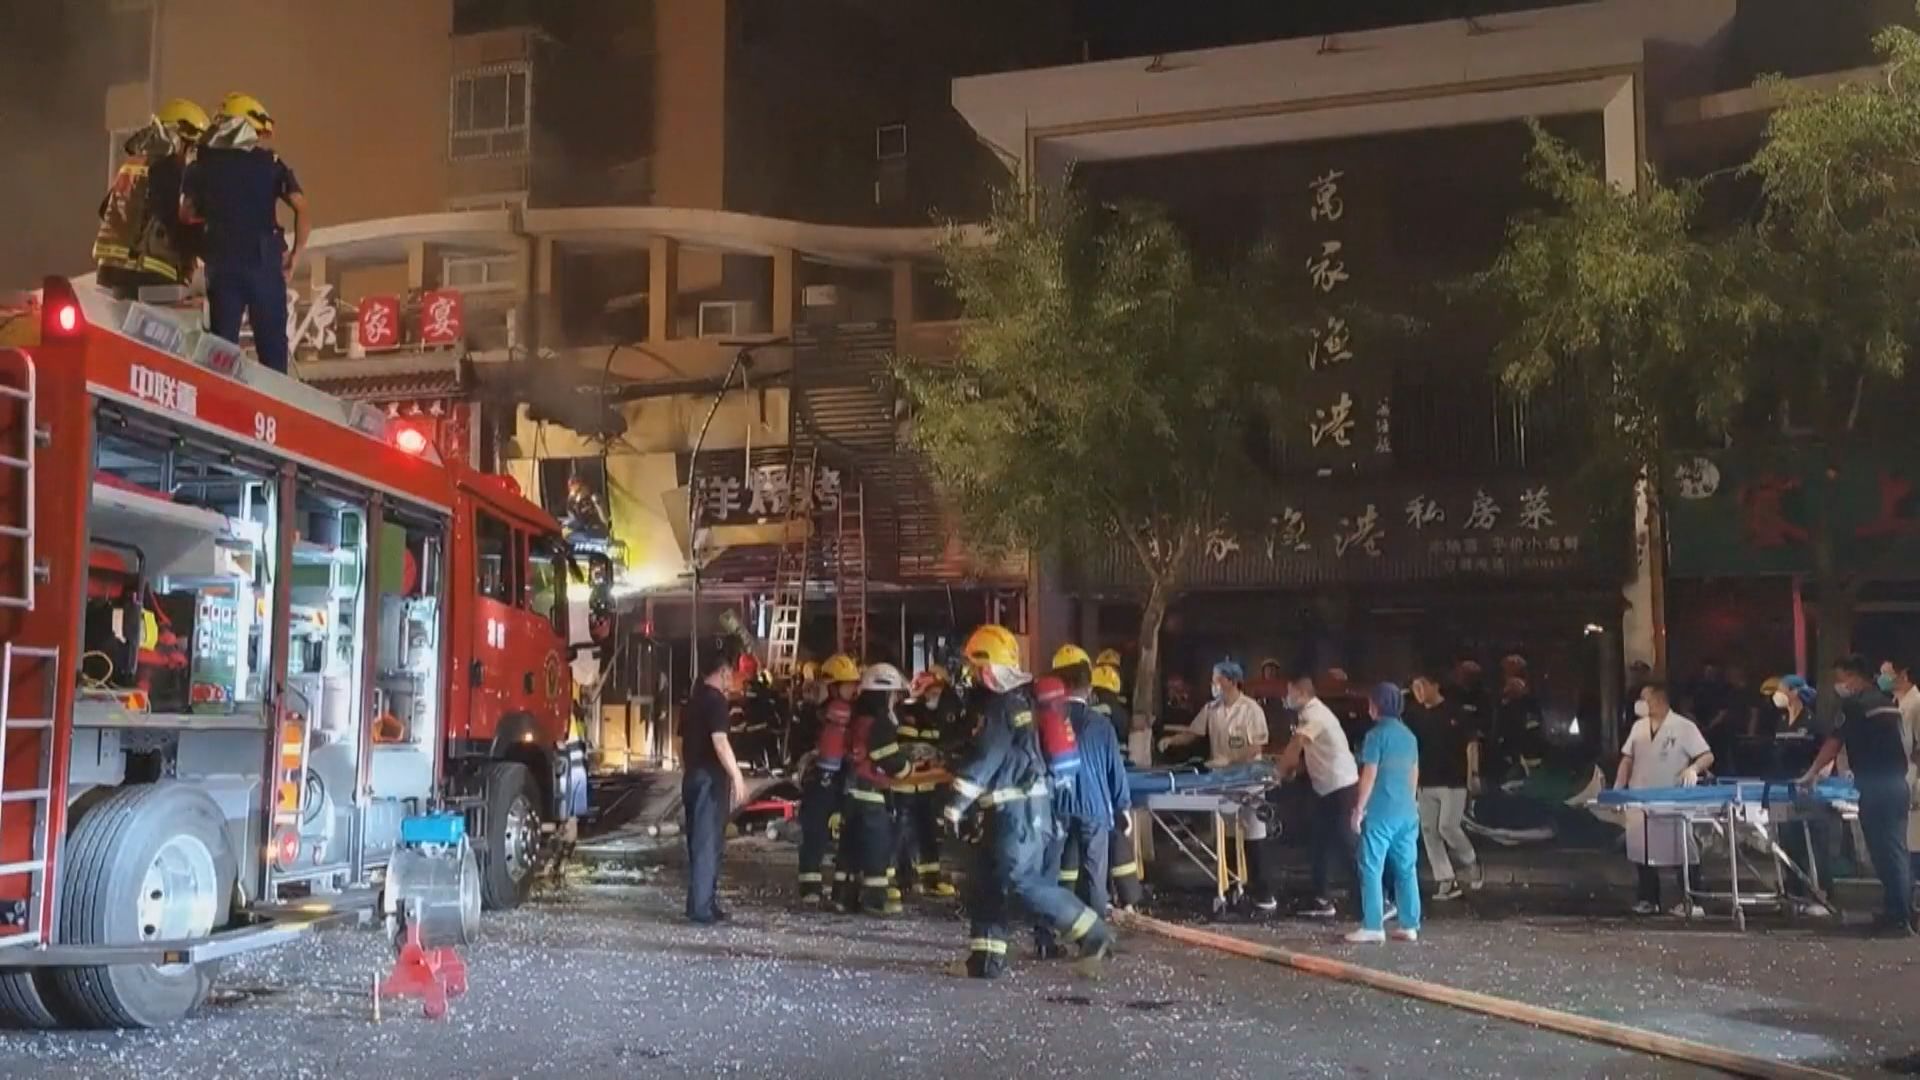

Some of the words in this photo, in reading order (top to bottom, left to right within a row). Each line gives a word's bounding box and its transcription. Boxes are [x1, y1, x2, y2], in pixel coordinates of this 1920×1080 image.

[254, 412, 277, 445] 98
[1404, 485, 1556, 531] 私房菜
